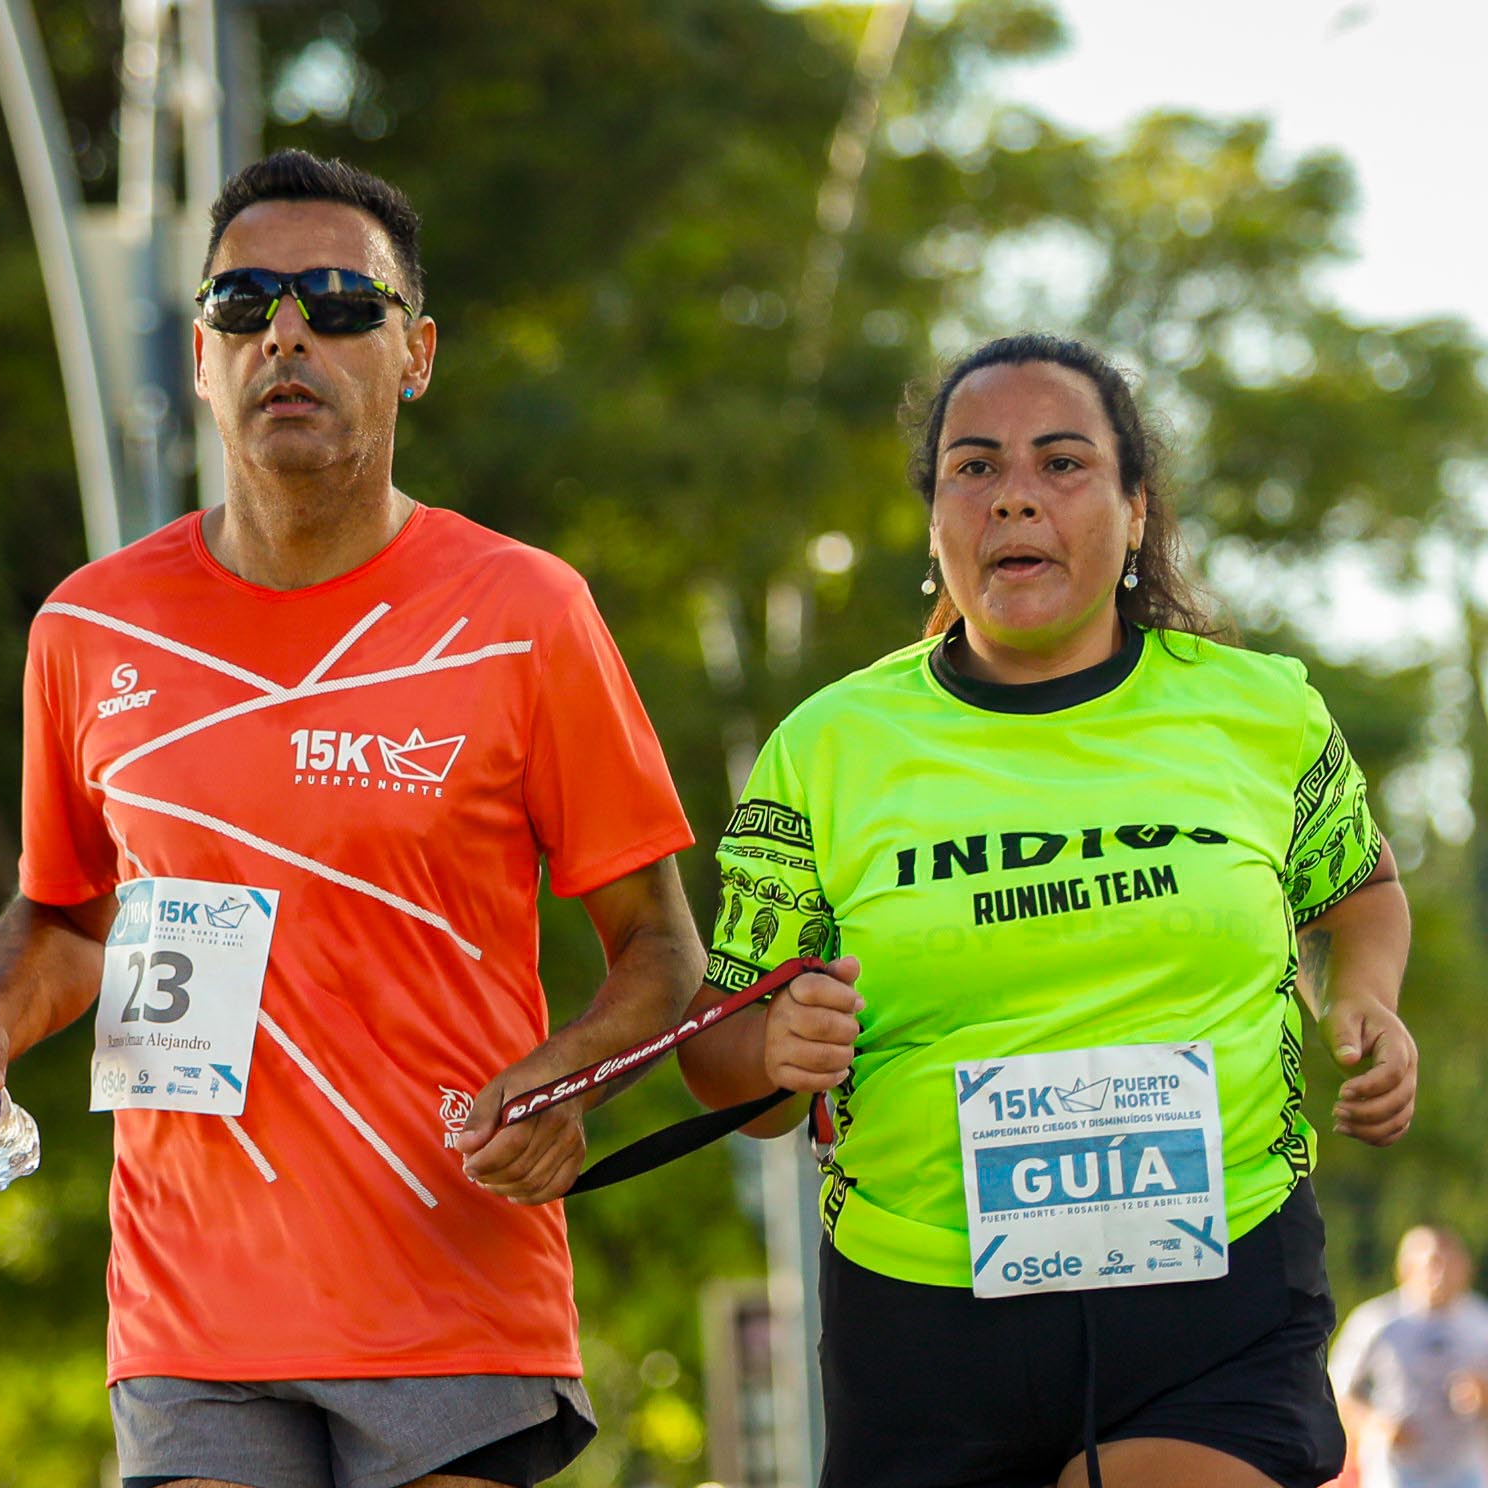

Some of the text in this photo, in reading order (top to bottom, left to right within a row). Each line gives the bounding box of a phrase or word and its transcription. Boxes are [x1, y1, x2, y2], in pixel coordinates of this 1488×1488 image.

[290, 729, 375, 773] 15K
[294, 774, 443, 798] PUERTO NORTE
[973, 864, 1179, 926] RUNING TEAM
[158, 900, 200, 925] 15K
[120, 950, 194, 1024] 23
[146, 1032, 211, 1051] Alejandro
[550, 1033, 676, 1101] San Clemente
[1112, 1075, 1180, 1093] PUERTO
[989, 1086, 1056, 1121] 15K
[1114, 1091, 1171, 1109] NORTE
[972, 1125, 1040, 1140] CAMPEONATO
[1042, 1120, 1078, 1133] CIEGOS
[1080, 1119, 1086, 1128] Y
[1155, 1110, 1201, 1122] VISUALES
[1012, 1135, 1177, 1203] GUÍA
[981, 1212, 1019, 1224] PUERTO
[1023, 1208, 1056, 1219] NORTE
[1068, 1204, 1110, 1215] ROSARIO
[1122, 1202, 1133, 1210] 12
[1137, 1200, 1149, 1209] DE
[1153, 1197, 1183, 1207] ABRIL
[1002, 1250, 1083, 1283] osde
